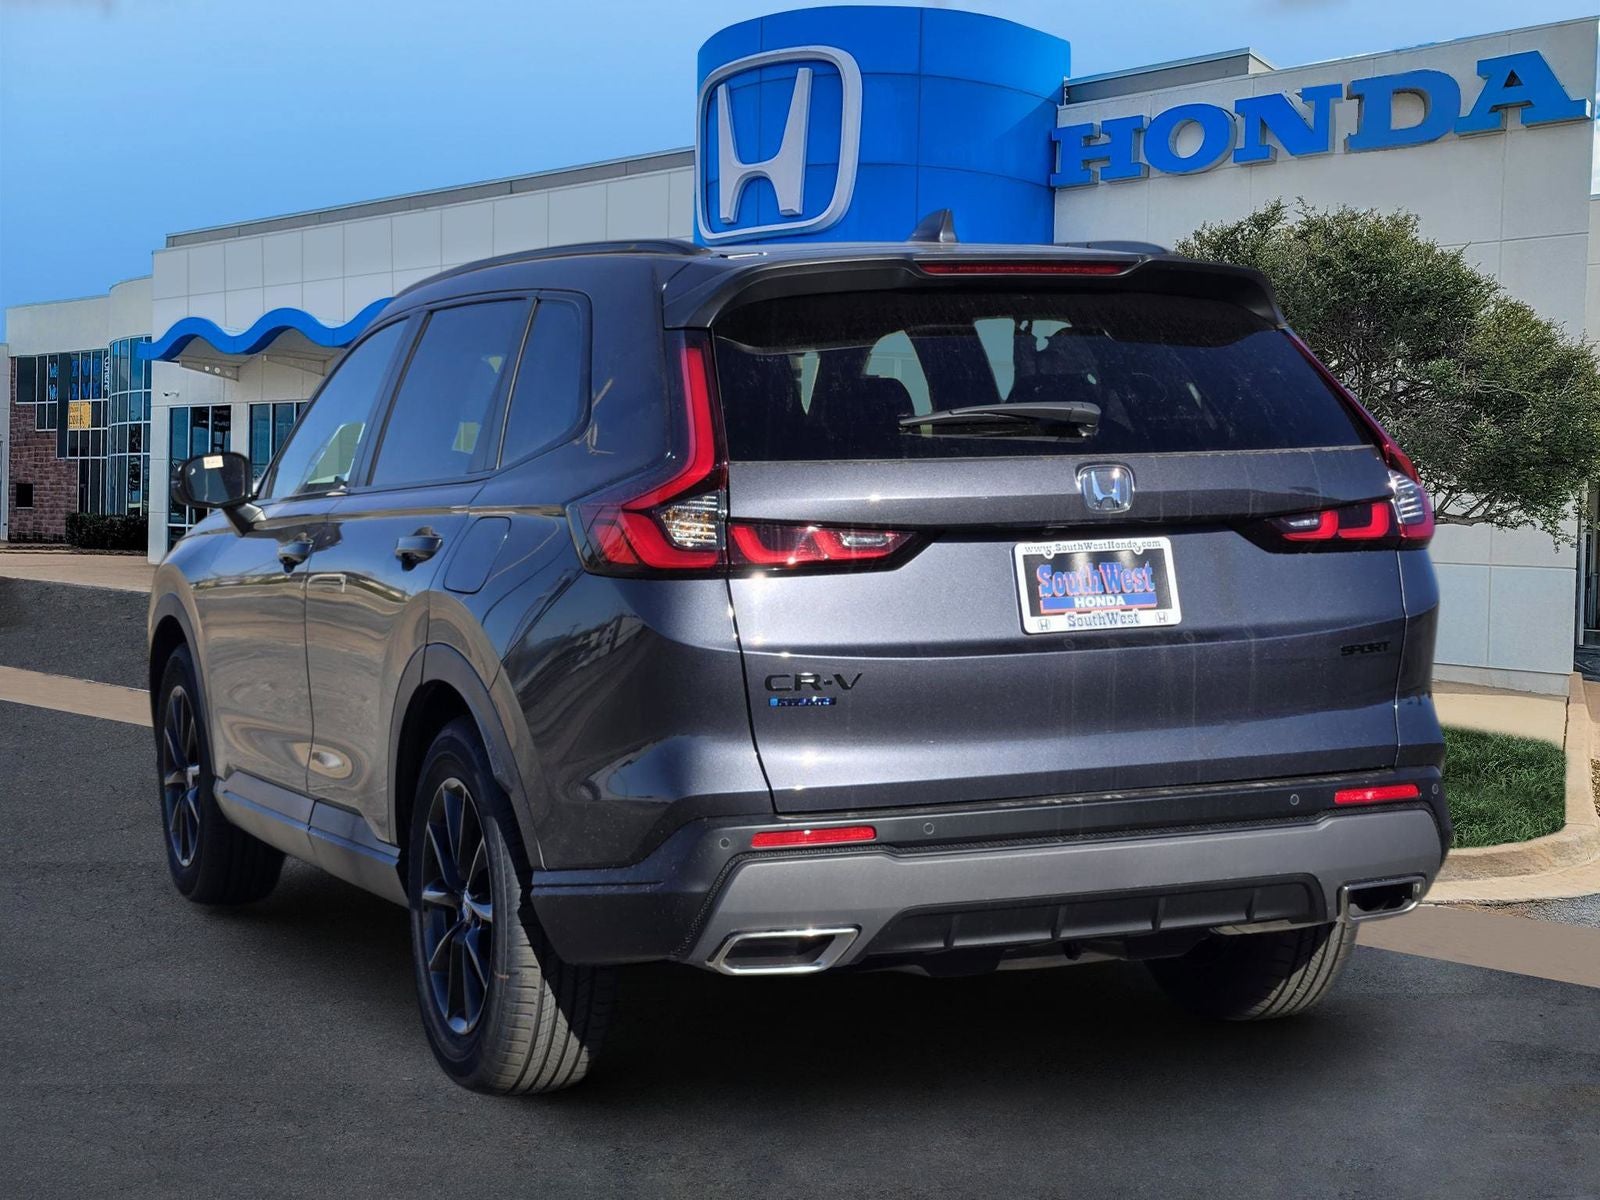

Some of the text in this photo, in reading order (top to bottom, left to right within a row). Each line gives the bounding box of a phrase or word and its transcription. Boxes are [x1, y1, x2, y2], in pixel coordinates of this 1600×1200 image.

[1050, 50, 1591, 189] HONDA
[1075, 594, 1126, 608] HONDA
[1340, 640, 1391, 656] SPORT
[764, 672, 863, 691] CR-V
